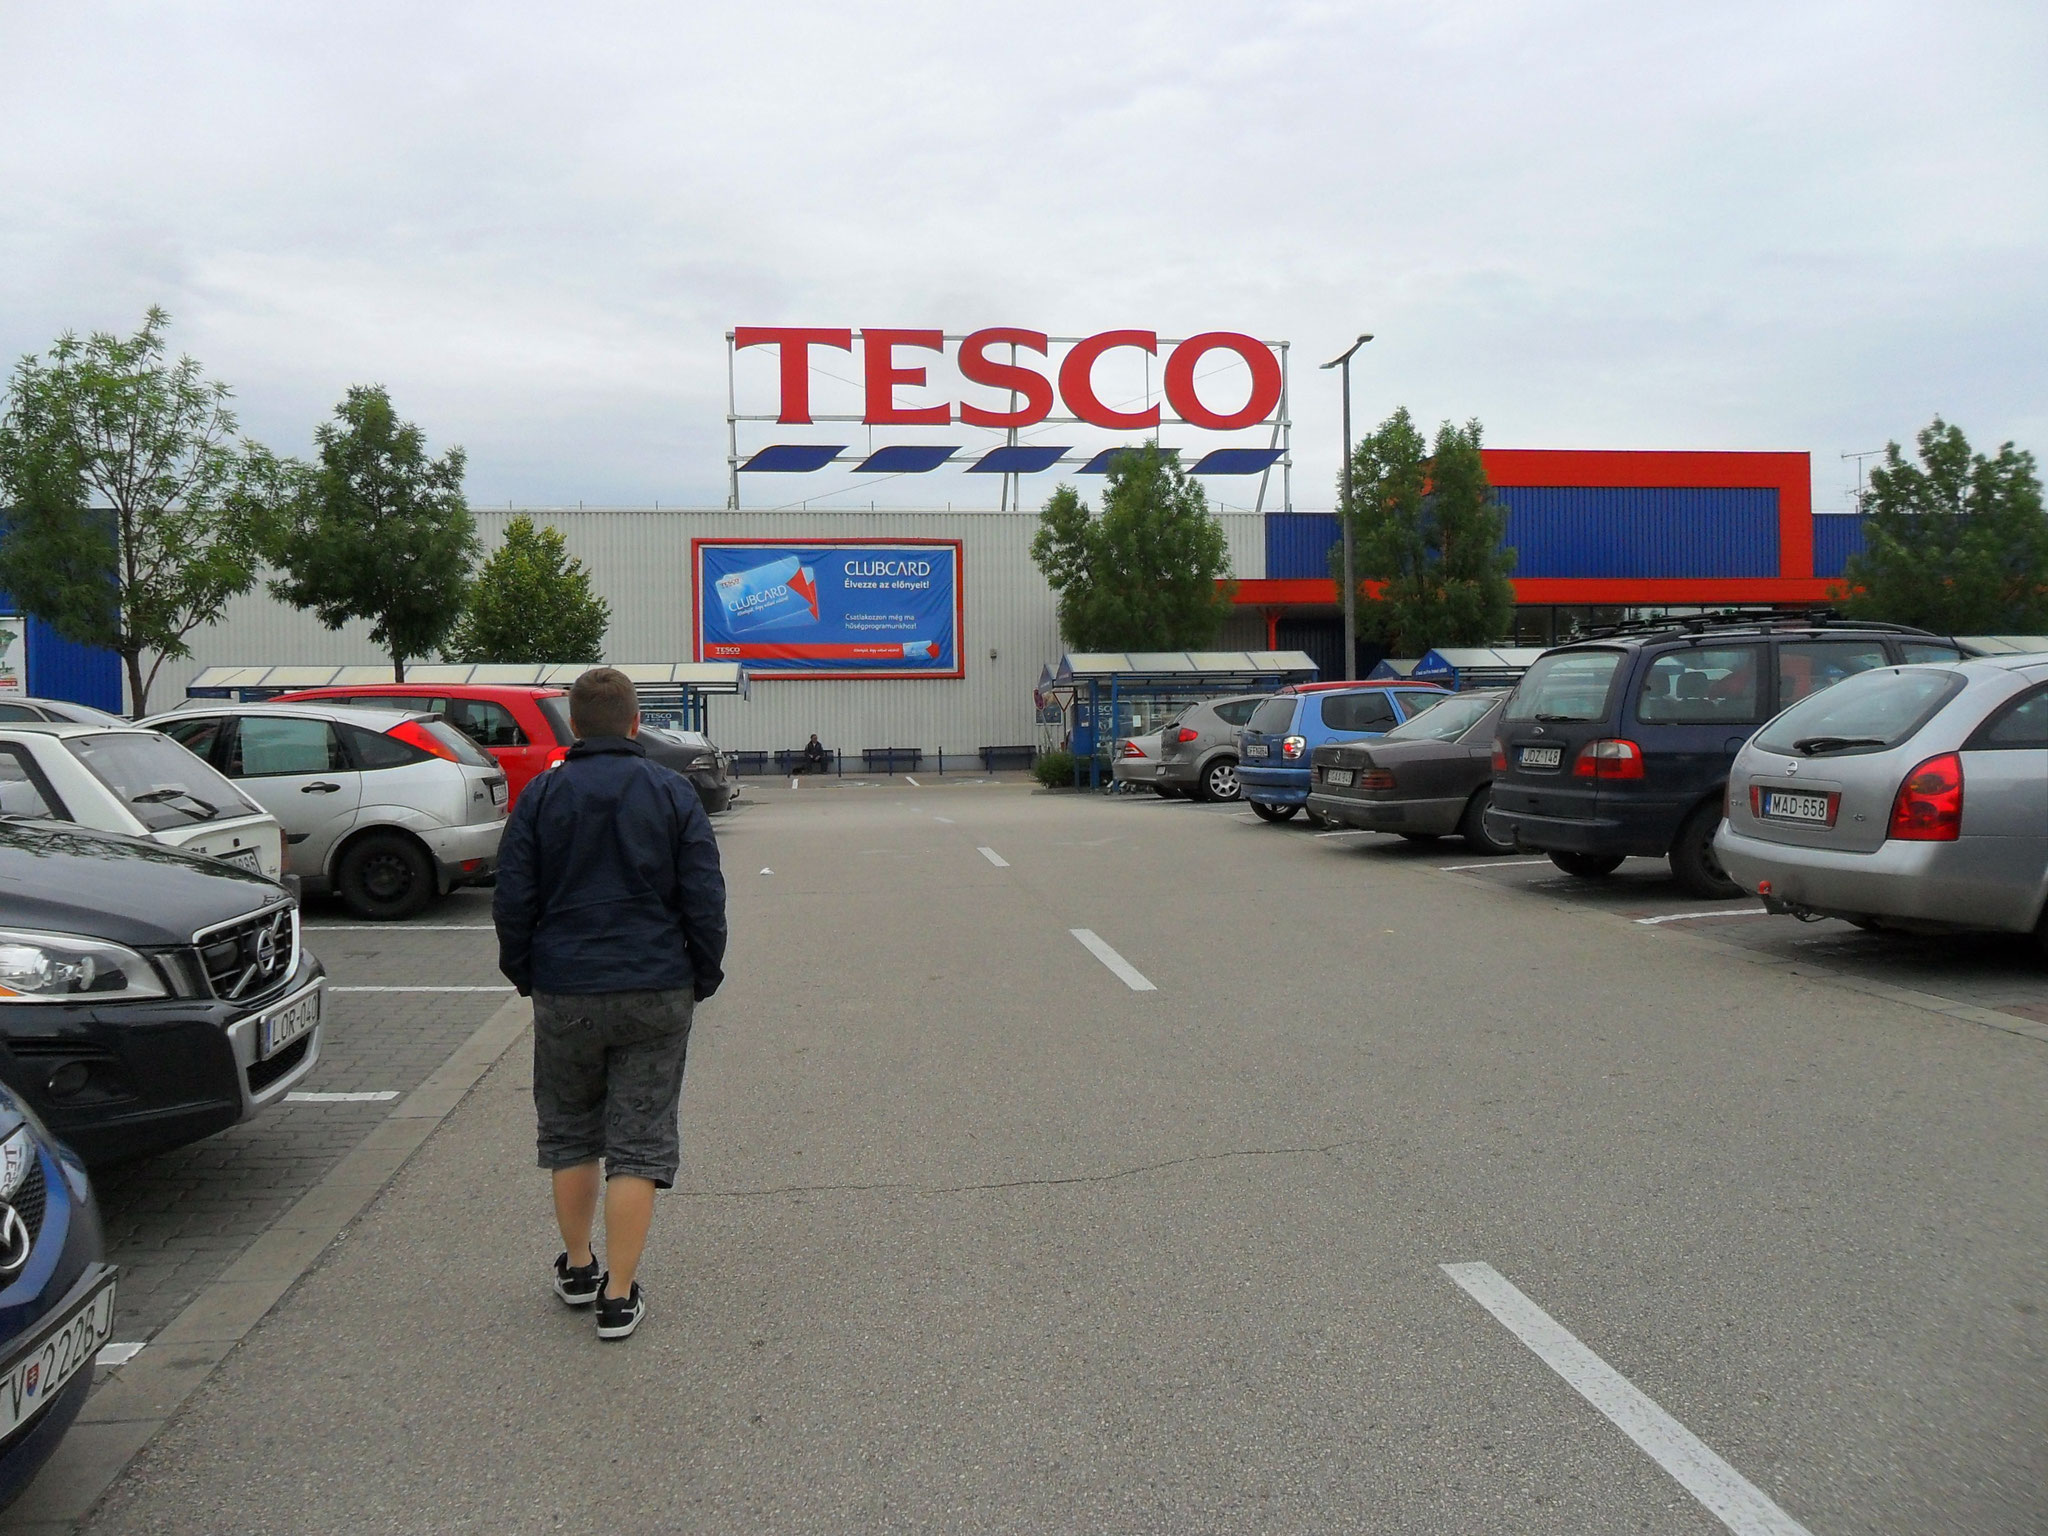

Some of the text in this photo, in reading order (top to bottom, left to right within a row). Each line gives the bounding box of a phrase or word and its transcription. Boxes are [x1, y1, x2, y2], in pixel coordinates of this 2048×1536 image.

[735, 327, 1282, 430] TESCO
[844, 561, 930, 576] CLUBCARD
[721, 578, 740, 588] TESCO
[844, 578, 877, 588] Élvezze
[891, 580, 930, 590] előnyeit!
[728, 585, 787, 612] CLUBCARD
[845, 613, 887, 621] Csatlakozzon
[888, 614, 903, 622] még
[1524, 749, 1559, 763] JDZ-148
[1772, 795, 1826, 818] MAD-658
